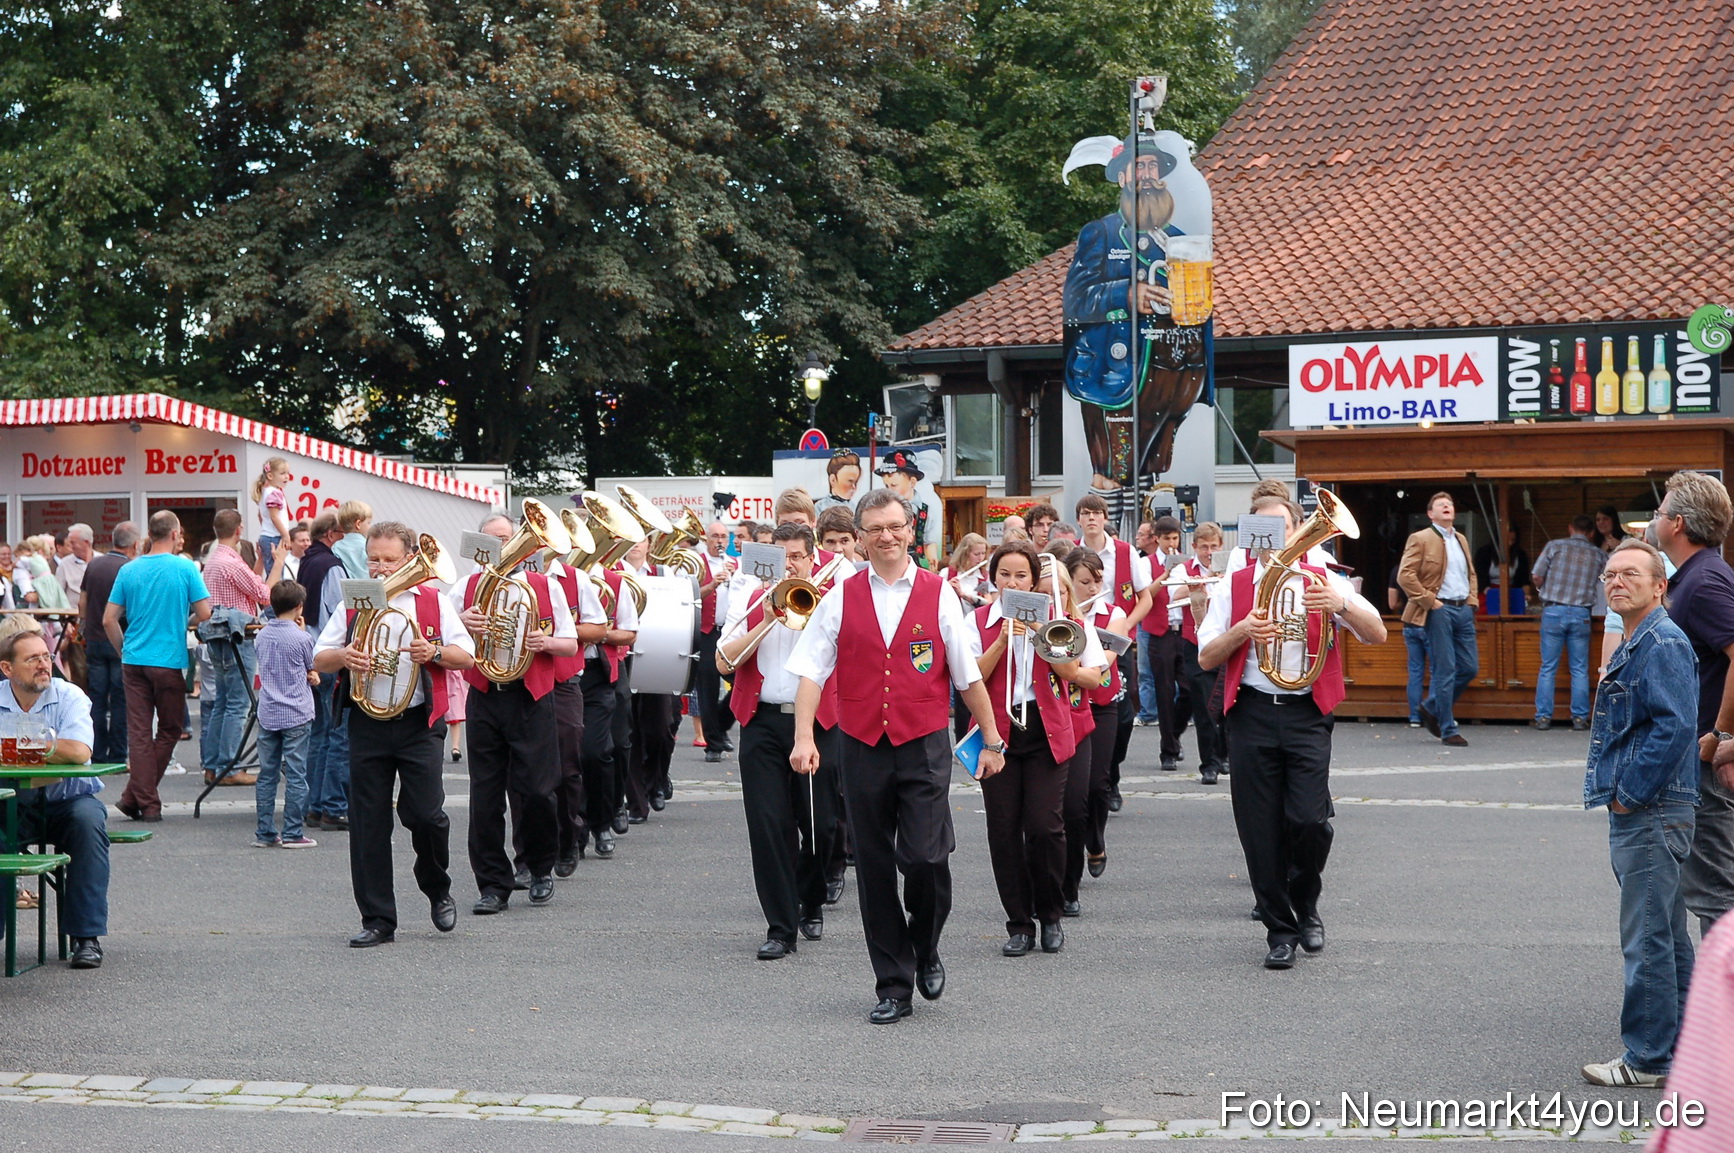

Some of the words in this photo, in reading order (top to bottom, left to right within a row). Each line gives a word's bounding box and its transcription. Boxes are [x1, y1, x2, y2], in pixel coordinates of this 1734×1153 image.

[1300, 344, 1485, 393] OLYMPIA
[1507, 337, 1541, 412] now
[1328, 399, 1458, 421] Limo-BAR
[21, 453, 126, 478] Dotzauer
[144, 449, 237, 475] Brez'n
[652, 494, 704, 506] GETRÄNKE
